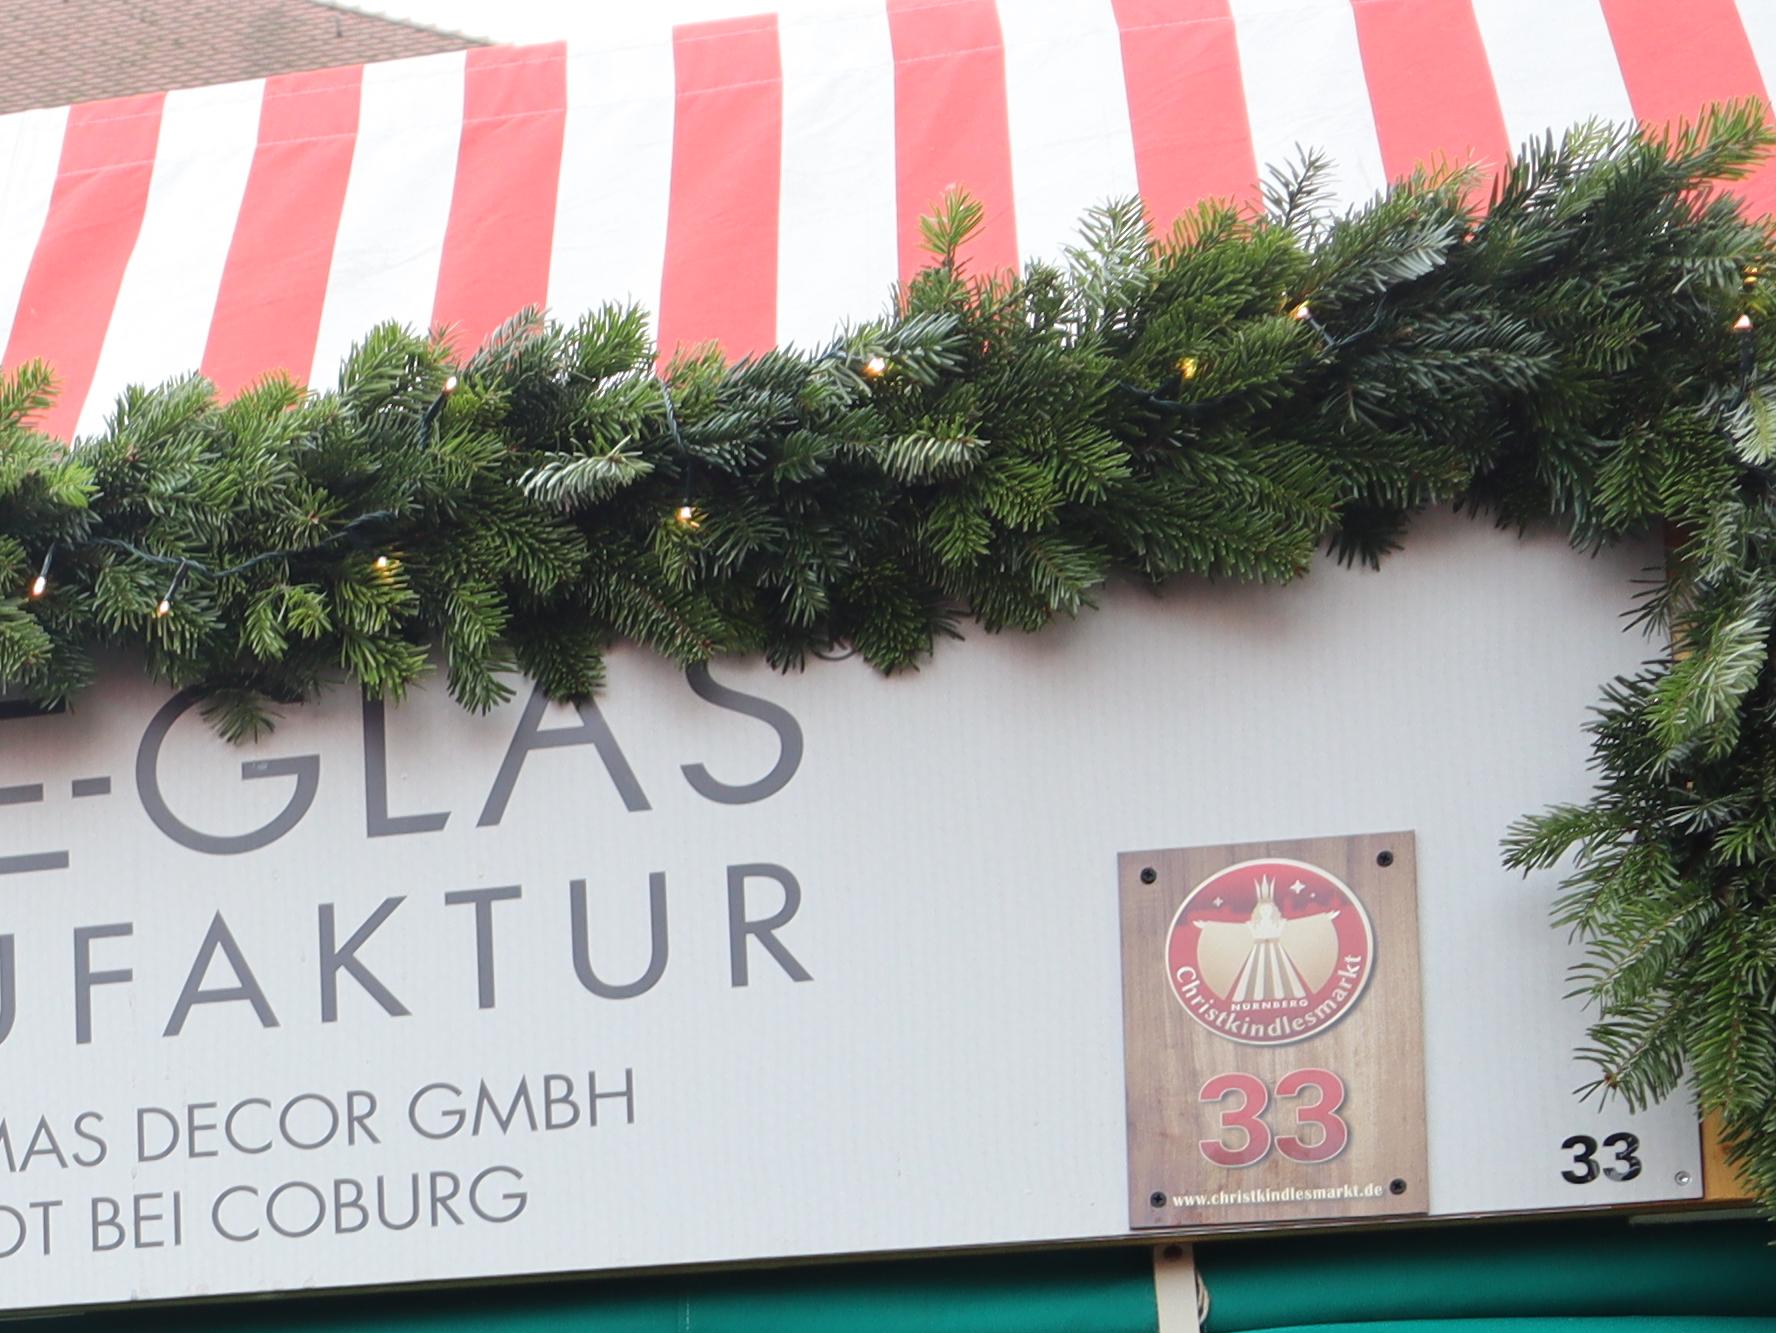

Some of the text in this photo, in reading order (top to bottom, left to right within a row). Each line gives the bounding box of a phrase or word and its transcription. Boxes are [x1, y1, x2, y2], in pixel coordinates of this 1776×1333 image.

[1175, 953, 1363, 1040] Christkindlesmarkt
[136, 1090, 382, 1163] DECOR
[407, 1067, 636, 1140] GMBH
[1197, 1068, 1349, 1169] 33
[1560, 1131, 1643, 1186] 33
[90, 1190, 184, 1254] BEI
[211, 1165, 529, 1242] COBURG
[1172, 1182, 1384, 1208] www.christkindlesmarkt.de
